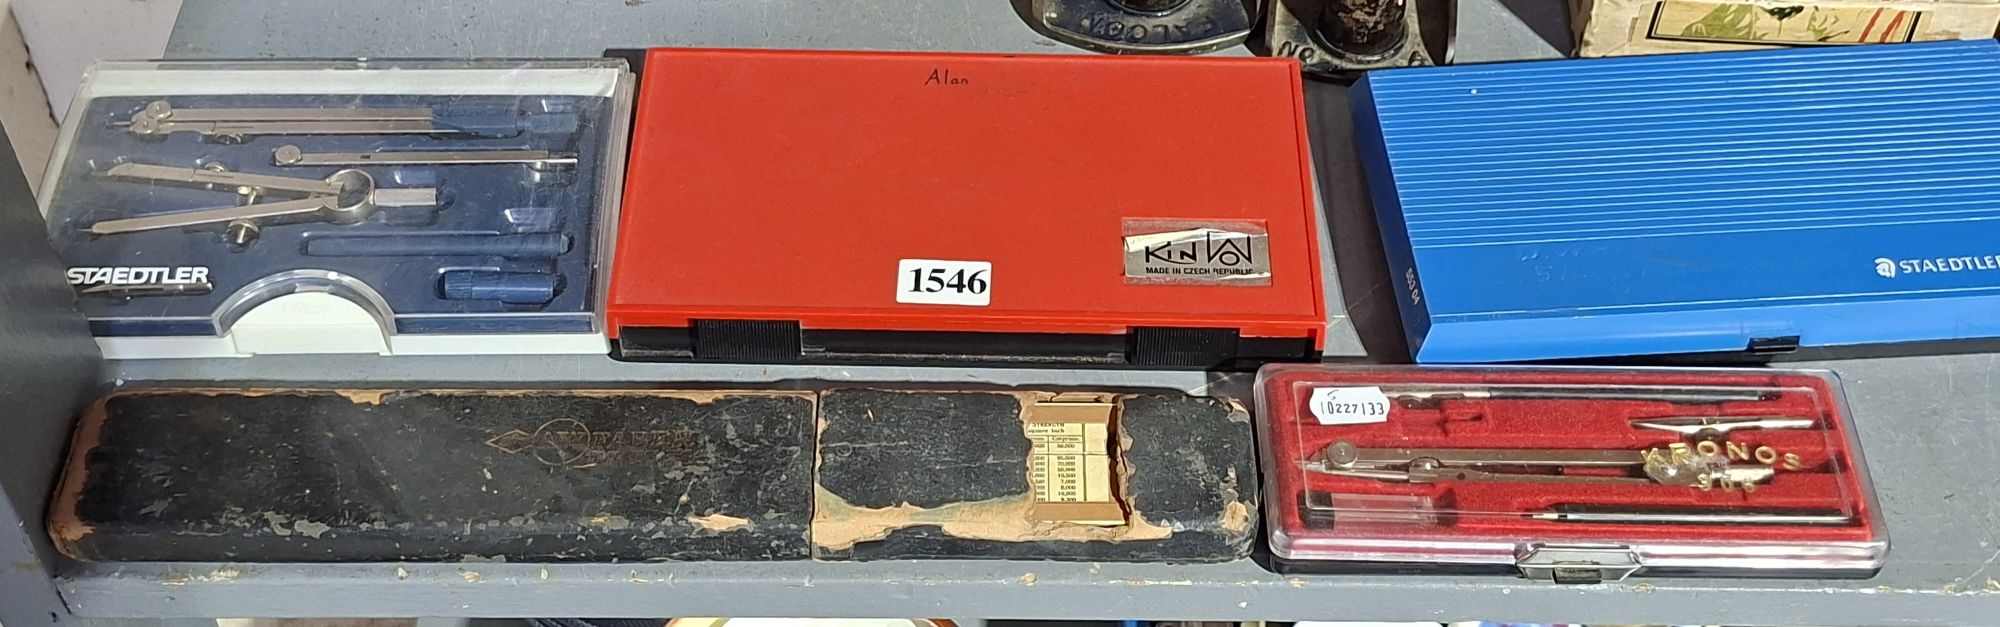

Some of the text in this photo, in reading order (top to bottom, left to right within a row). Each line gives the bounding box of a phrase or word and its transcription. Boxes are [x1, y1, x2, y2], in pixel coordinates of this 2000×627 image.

[924, 69, 969, 86] Alan
[66, 266, 209, 285] STAEDTLER
[1145, 267, 1254, 276] MADE IN CZECH REPUBLIC
[907, 267, 988, 295] 1546
[1320, 401, 1385, 416] 10227133
[1640, 440, 1801, 472] KRONOS
